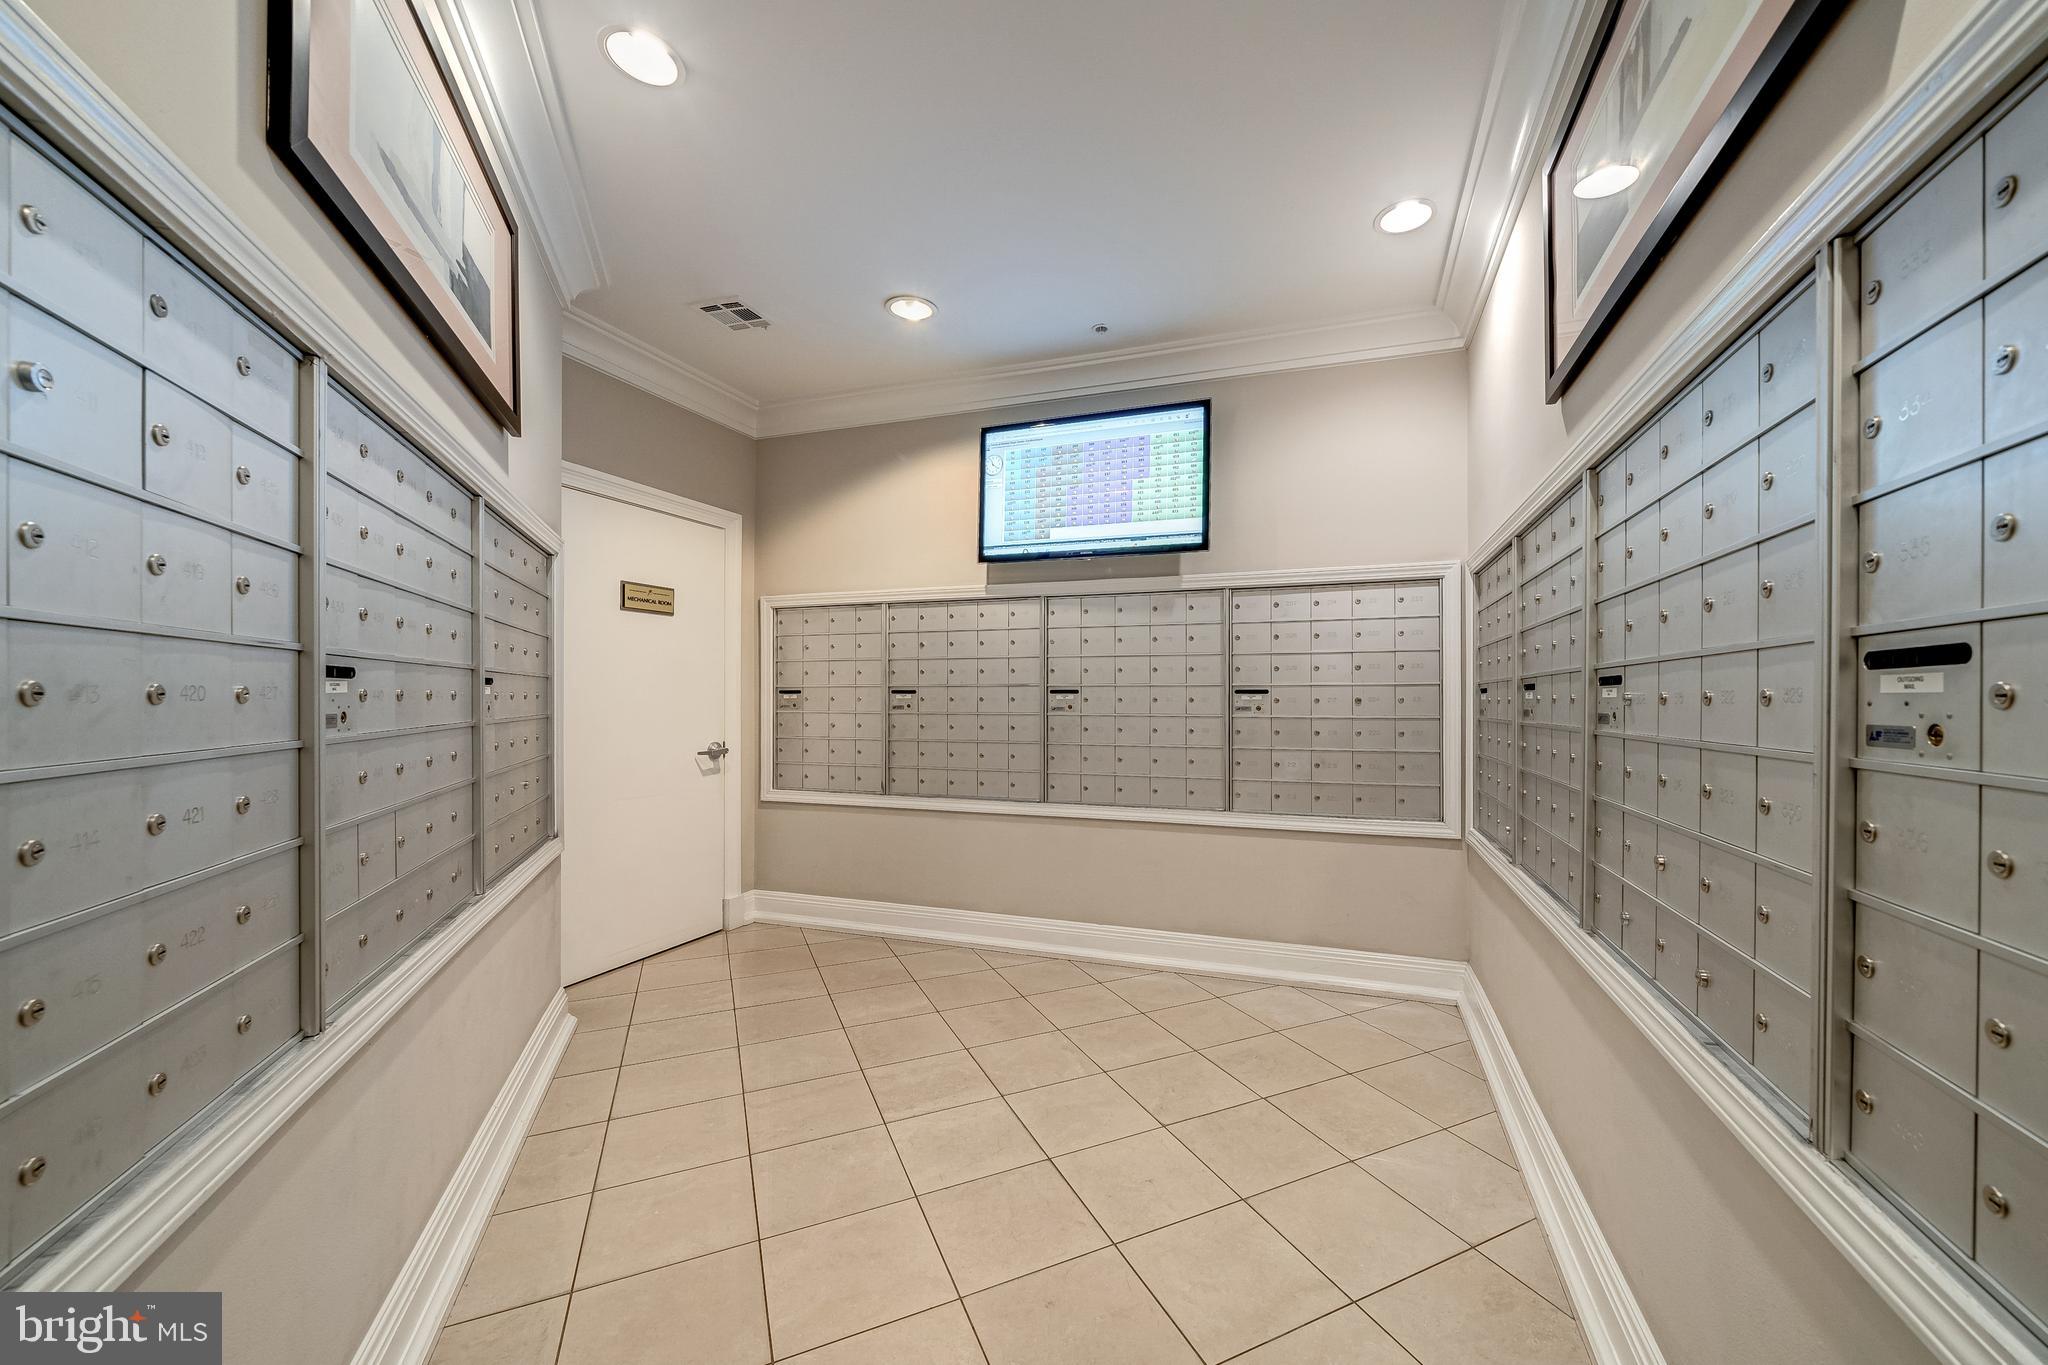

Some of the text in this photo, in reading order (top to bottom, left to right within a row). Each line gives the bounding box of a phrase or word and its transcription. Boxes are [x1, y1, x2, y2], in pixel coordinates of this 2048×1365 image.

[627, 596, 657, 605] MECHANICAL
[180, 684, 206, 703] 420
[182, 806, 205, 825] 421
[180, 926, 206, 950] 422
